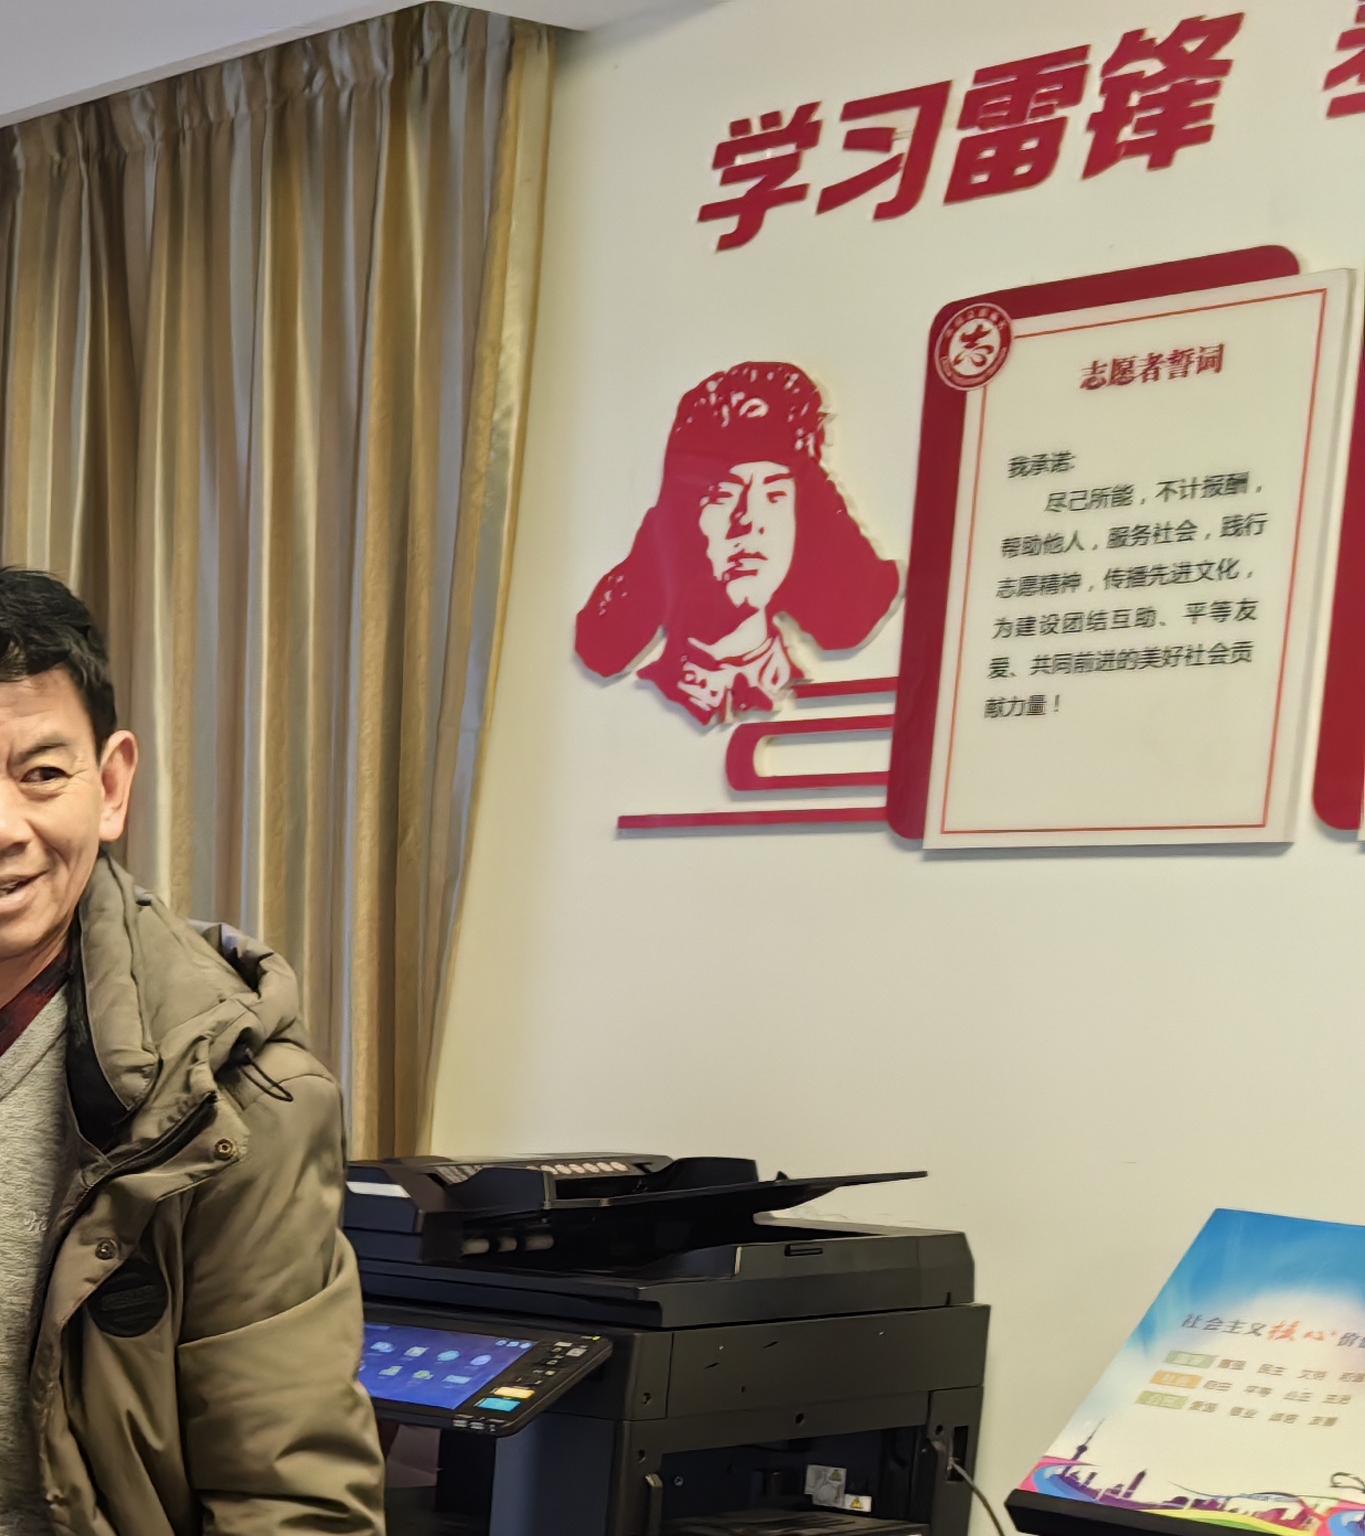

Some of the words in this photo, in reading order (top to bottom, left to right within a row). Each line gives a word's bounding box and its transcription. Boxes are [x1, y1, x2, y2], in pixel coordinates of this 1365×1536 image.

[697, 12, 1245, 253] 学习雷锋
[1080, 344, 1225, 390] 志愿者誓词
